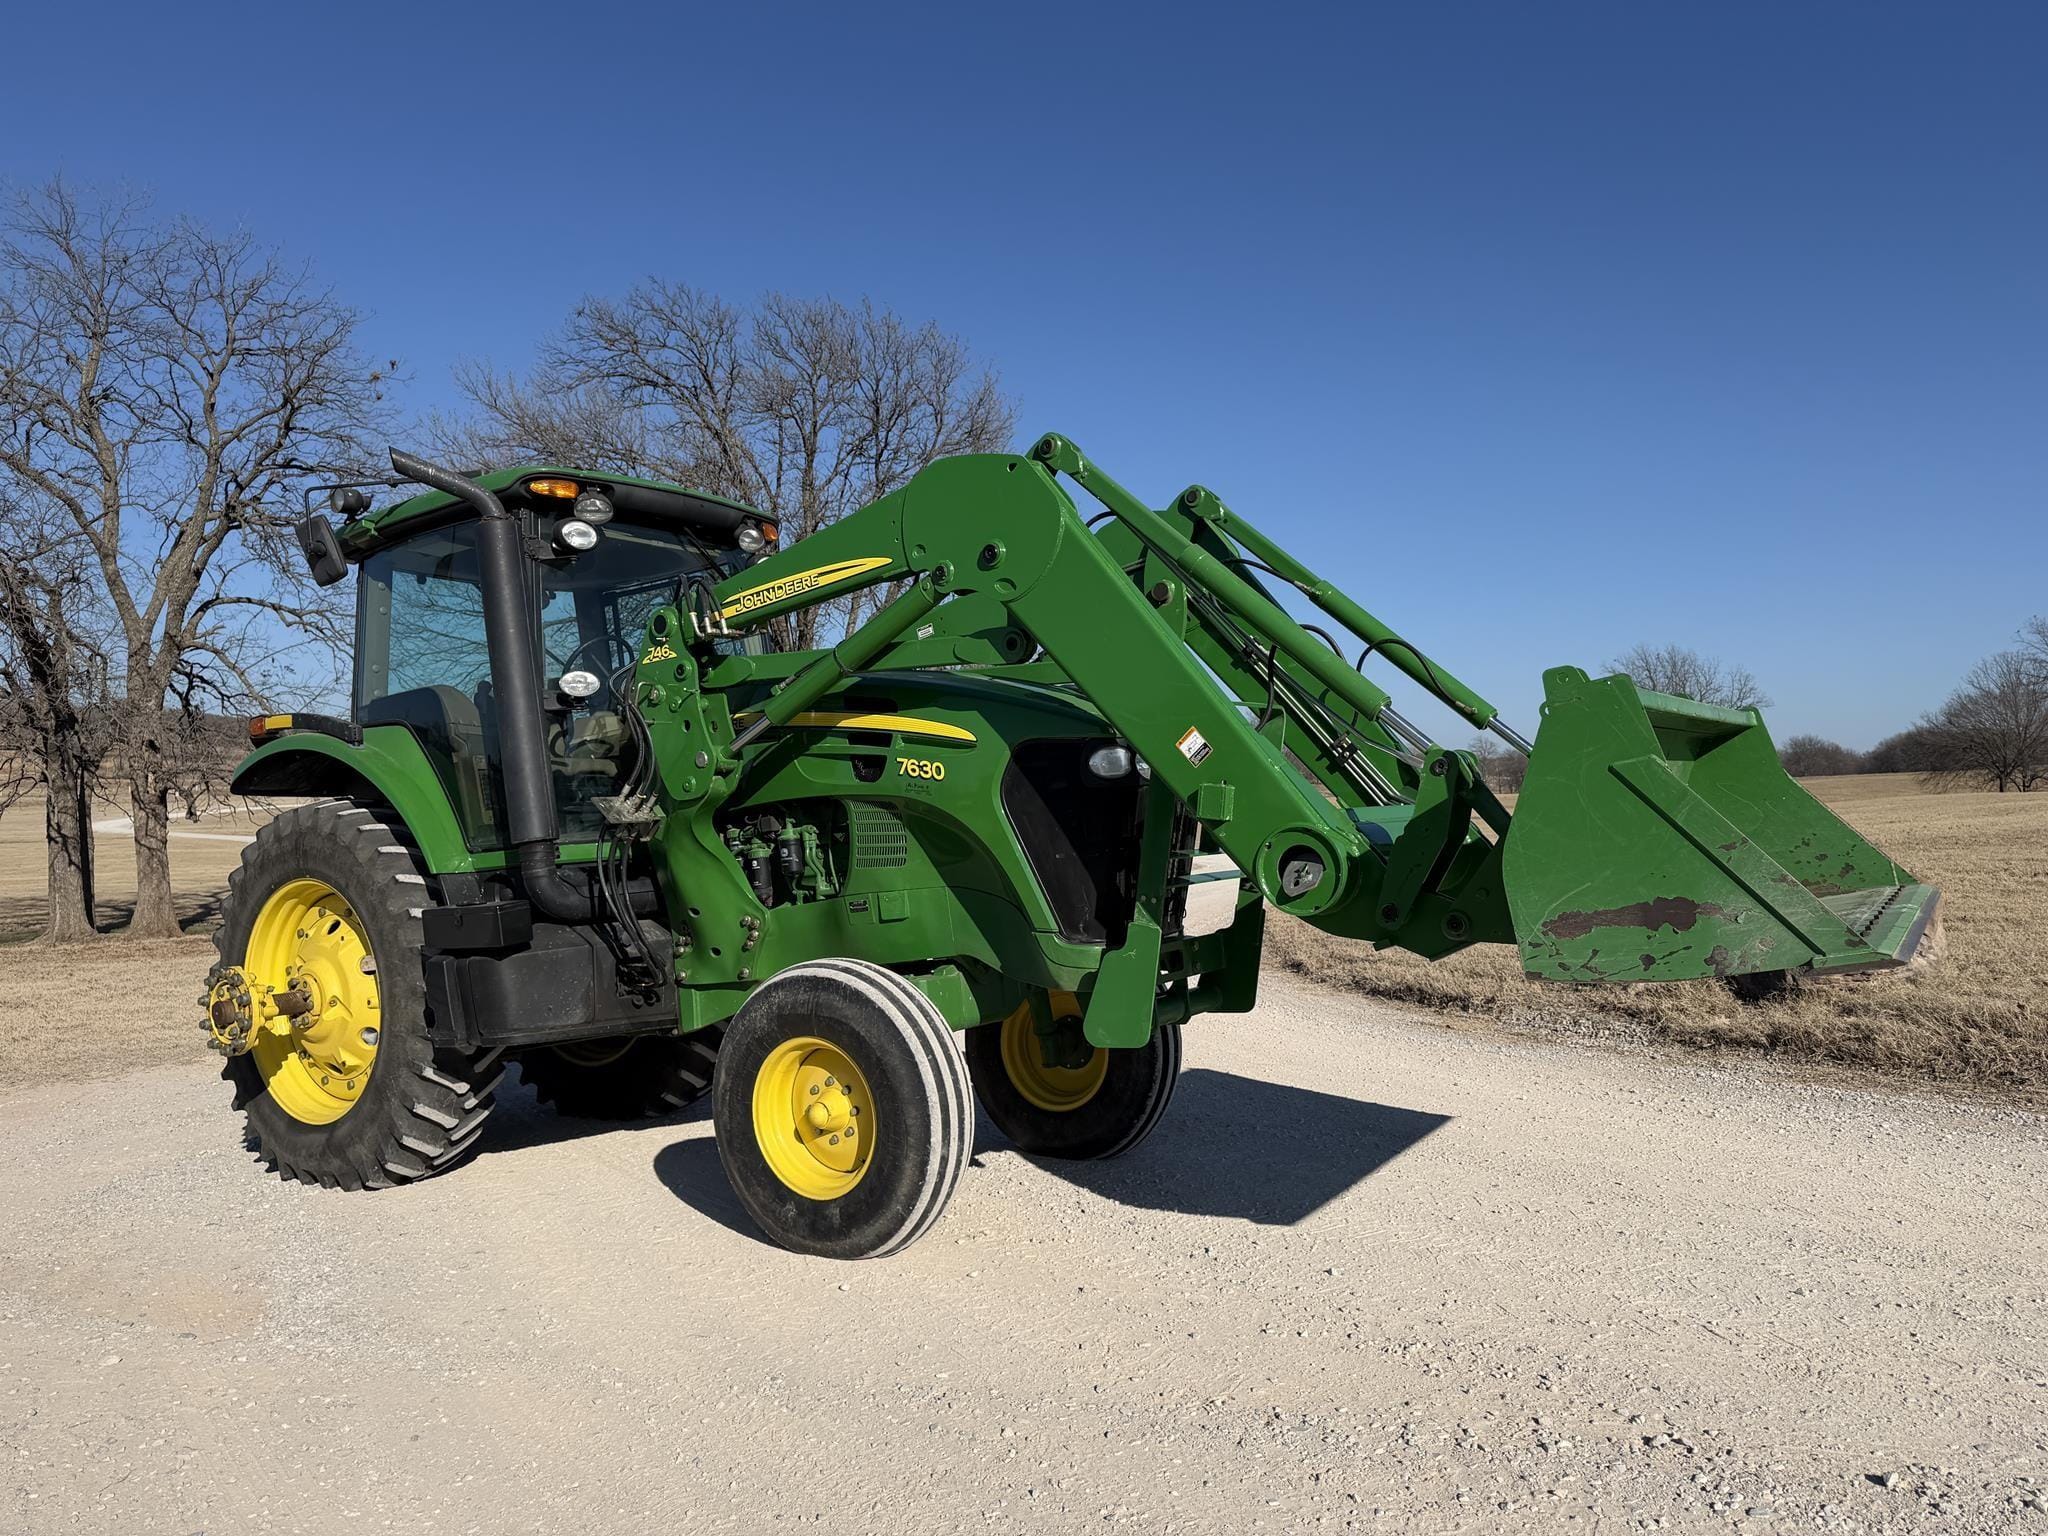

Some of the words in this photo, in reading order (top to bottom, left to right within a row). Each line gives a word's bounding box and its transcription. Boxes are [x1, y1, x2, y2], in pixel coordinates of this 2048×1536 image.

[736, 588, 774, 612] JOHN
[774, 574, 819, 598] DEERE
[647, 644, 670, 661] 746
[896, 757, 945, 781] 7630
